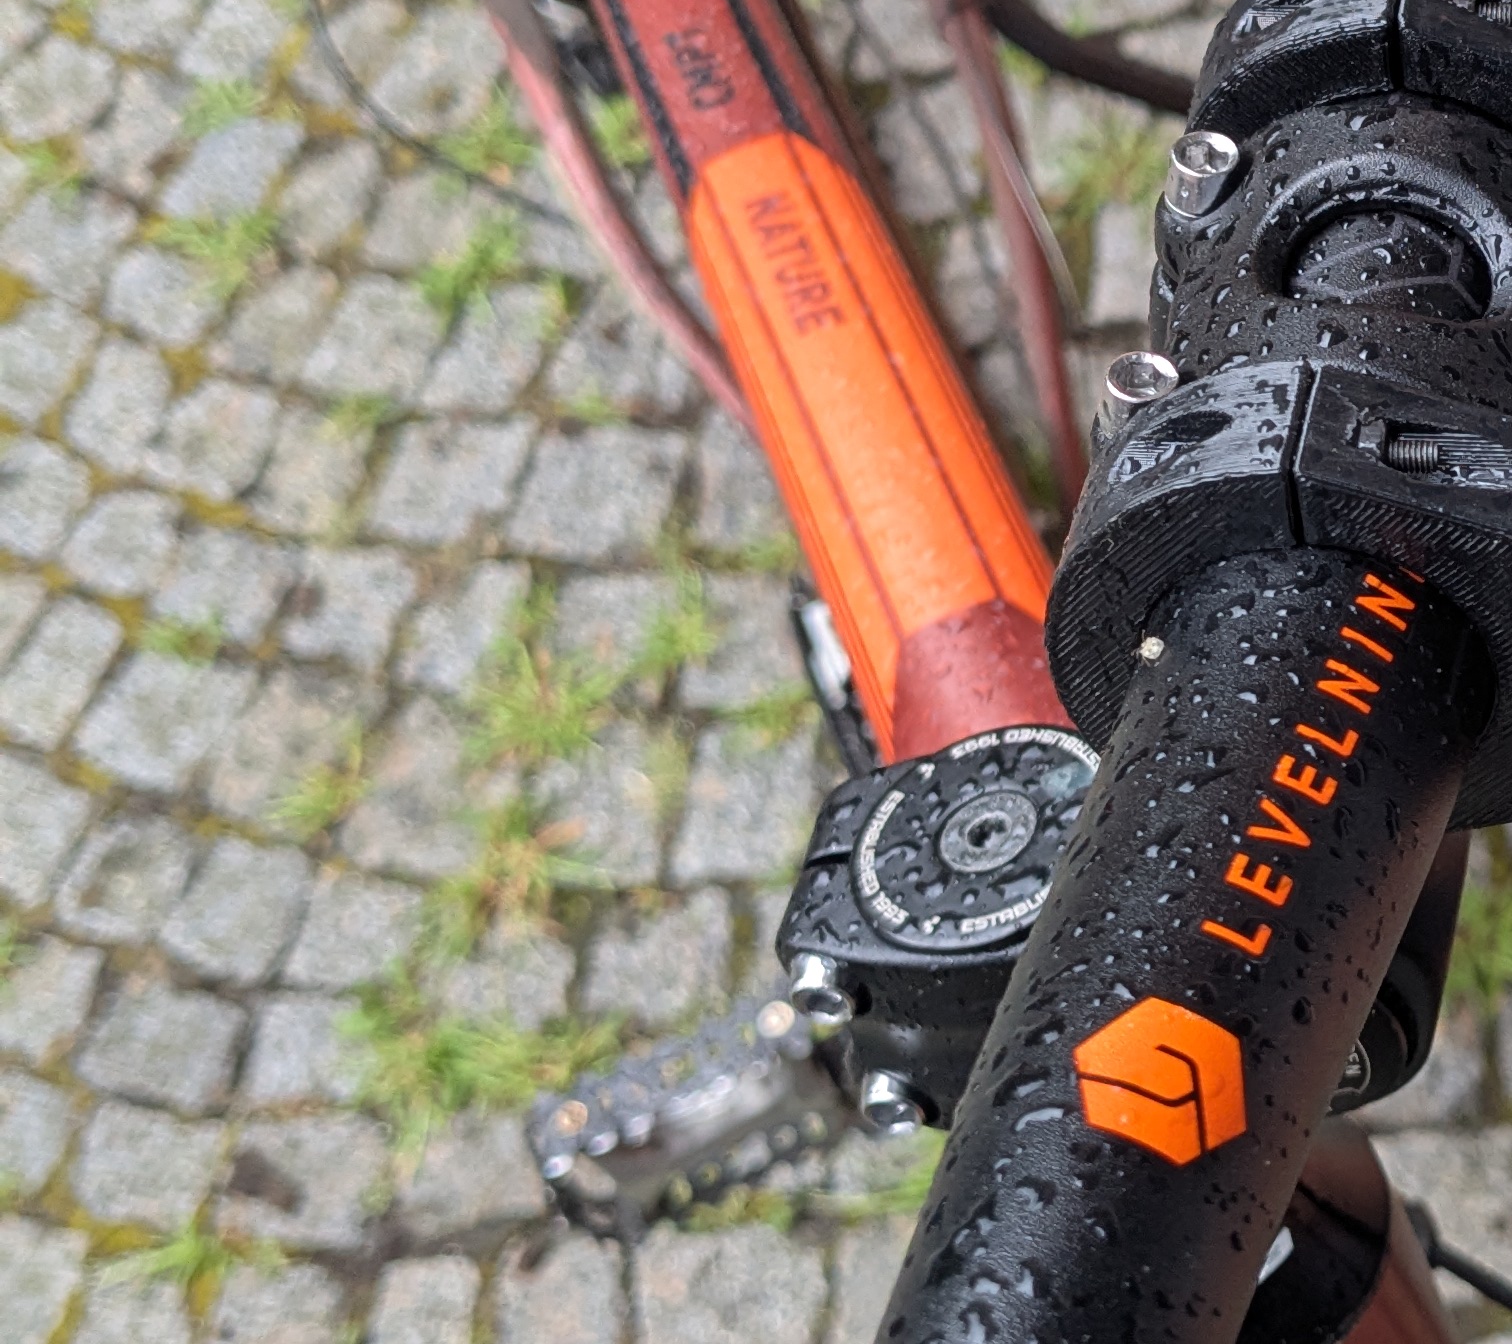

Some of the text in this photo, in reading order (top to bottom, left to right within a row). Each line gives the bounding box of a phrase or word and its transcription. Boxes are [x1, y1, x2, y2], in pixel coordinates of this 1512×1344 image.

[745, 188, 844, 337] NATURE
[1002, 727, 1103, 778] STABLISHED
[1200, 565, 1426, 957] LEVELNIN
[857, 789, 910, 932] ESTABLISHED 1993
